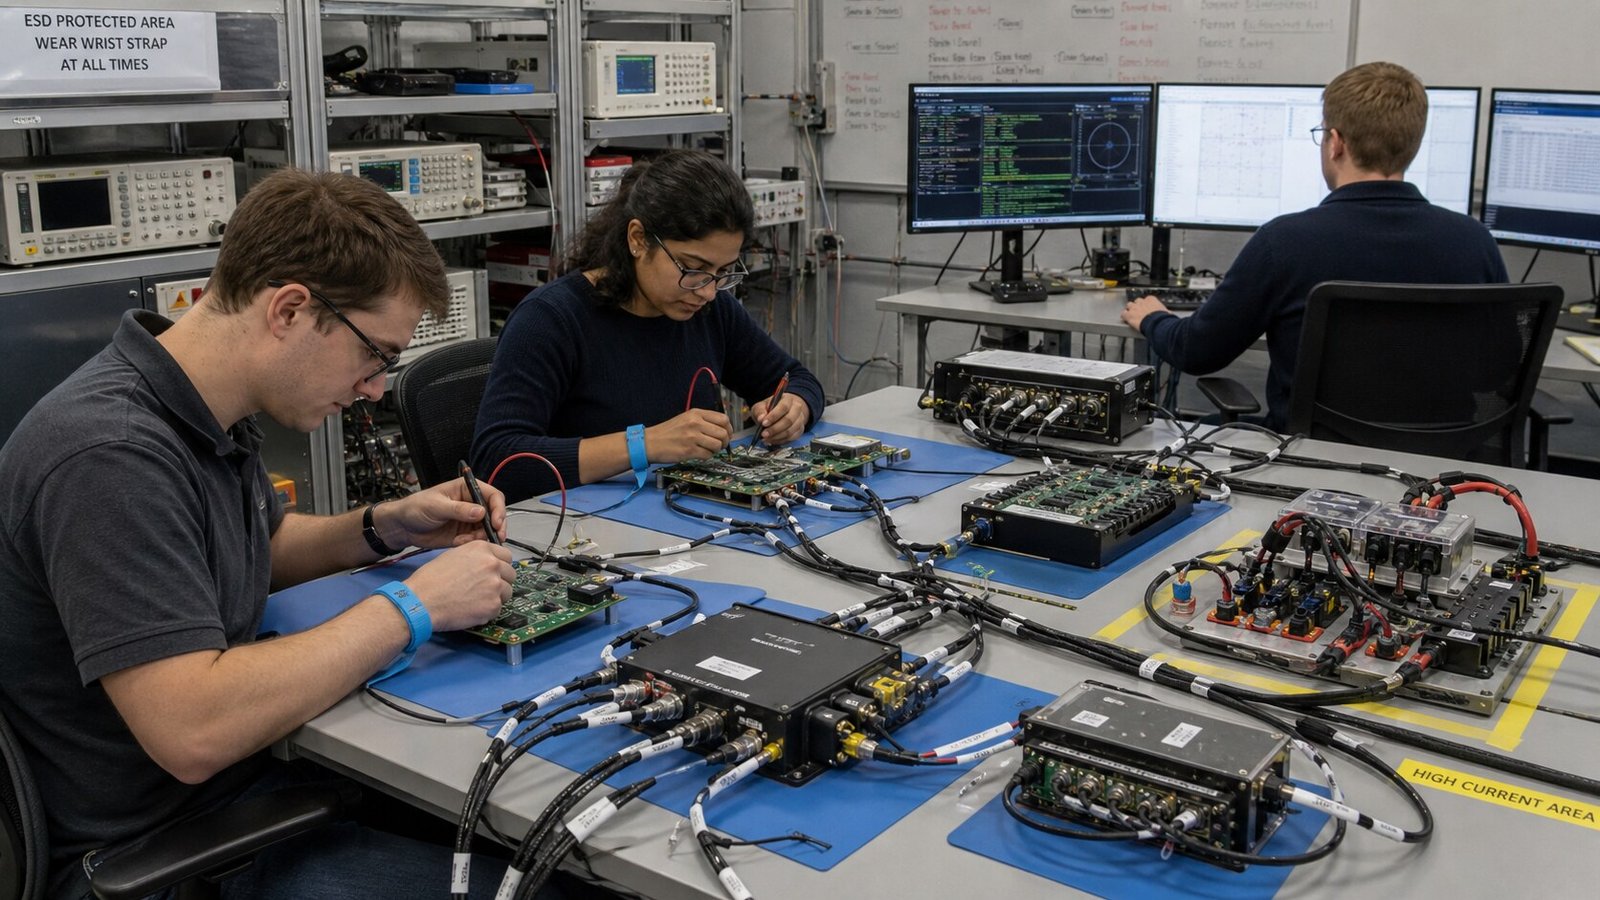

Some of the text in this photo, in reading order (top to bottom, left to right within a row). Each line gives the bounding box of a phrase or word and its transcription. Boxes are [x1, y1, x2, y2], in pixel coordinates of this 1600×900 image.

[24, 14, 175, 29] ESD PROTECTED AREA
[35, 37, 168, 50] WEAR WRIST STRAP
[60, 58, 149, 71] AT ALL TIMES
[1413, 768, 1595, 823] HIGH CURRENT AREA
